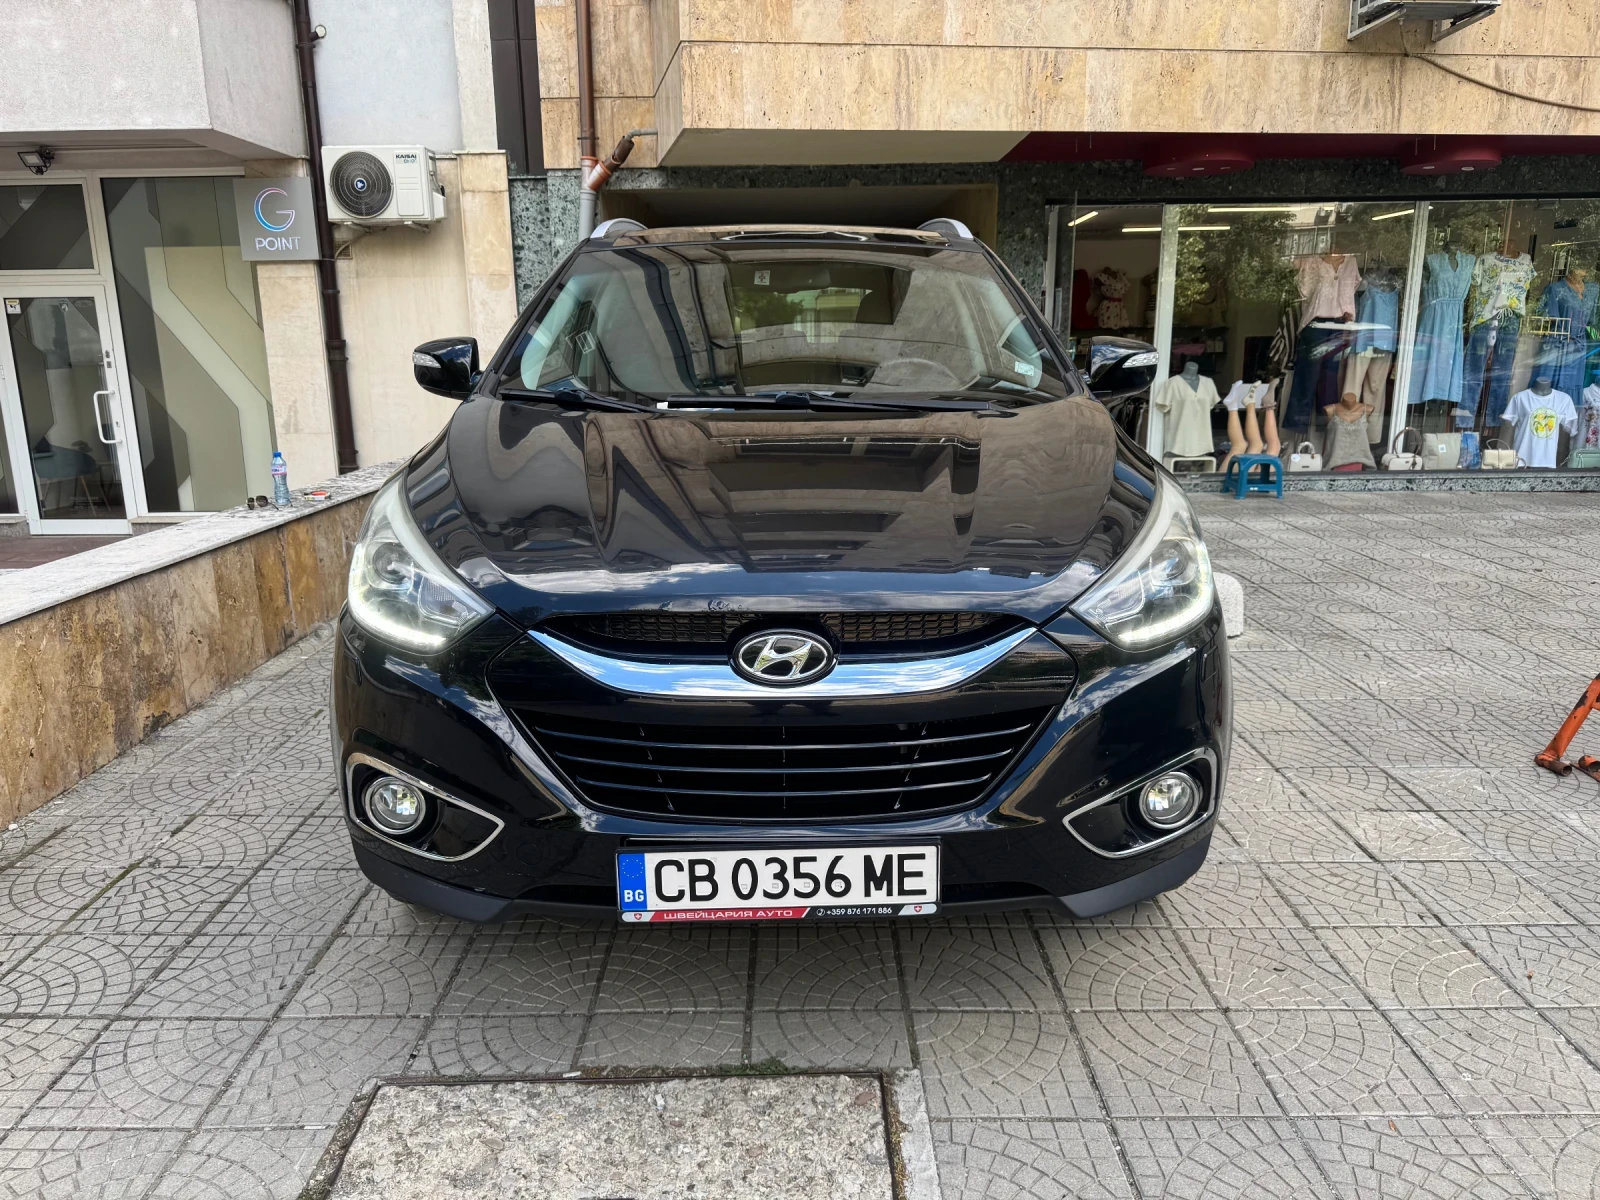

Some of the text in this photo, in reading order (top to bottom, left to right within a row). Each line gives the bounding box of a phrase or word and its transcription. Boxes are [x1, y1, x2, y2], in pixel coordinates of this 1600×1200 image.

[254, 187, 295, 232] G
[254, 236, 301, 251] POINT
[654, 853, 927, 902] CB 0356 ME
[623, 889, 645, 903] BG
[664, 910, 793, 920] ШВЕЙЦАРИЯ АУТО
[826, 908, 846, 916] +359
[862, 907, 876, 915] 171
